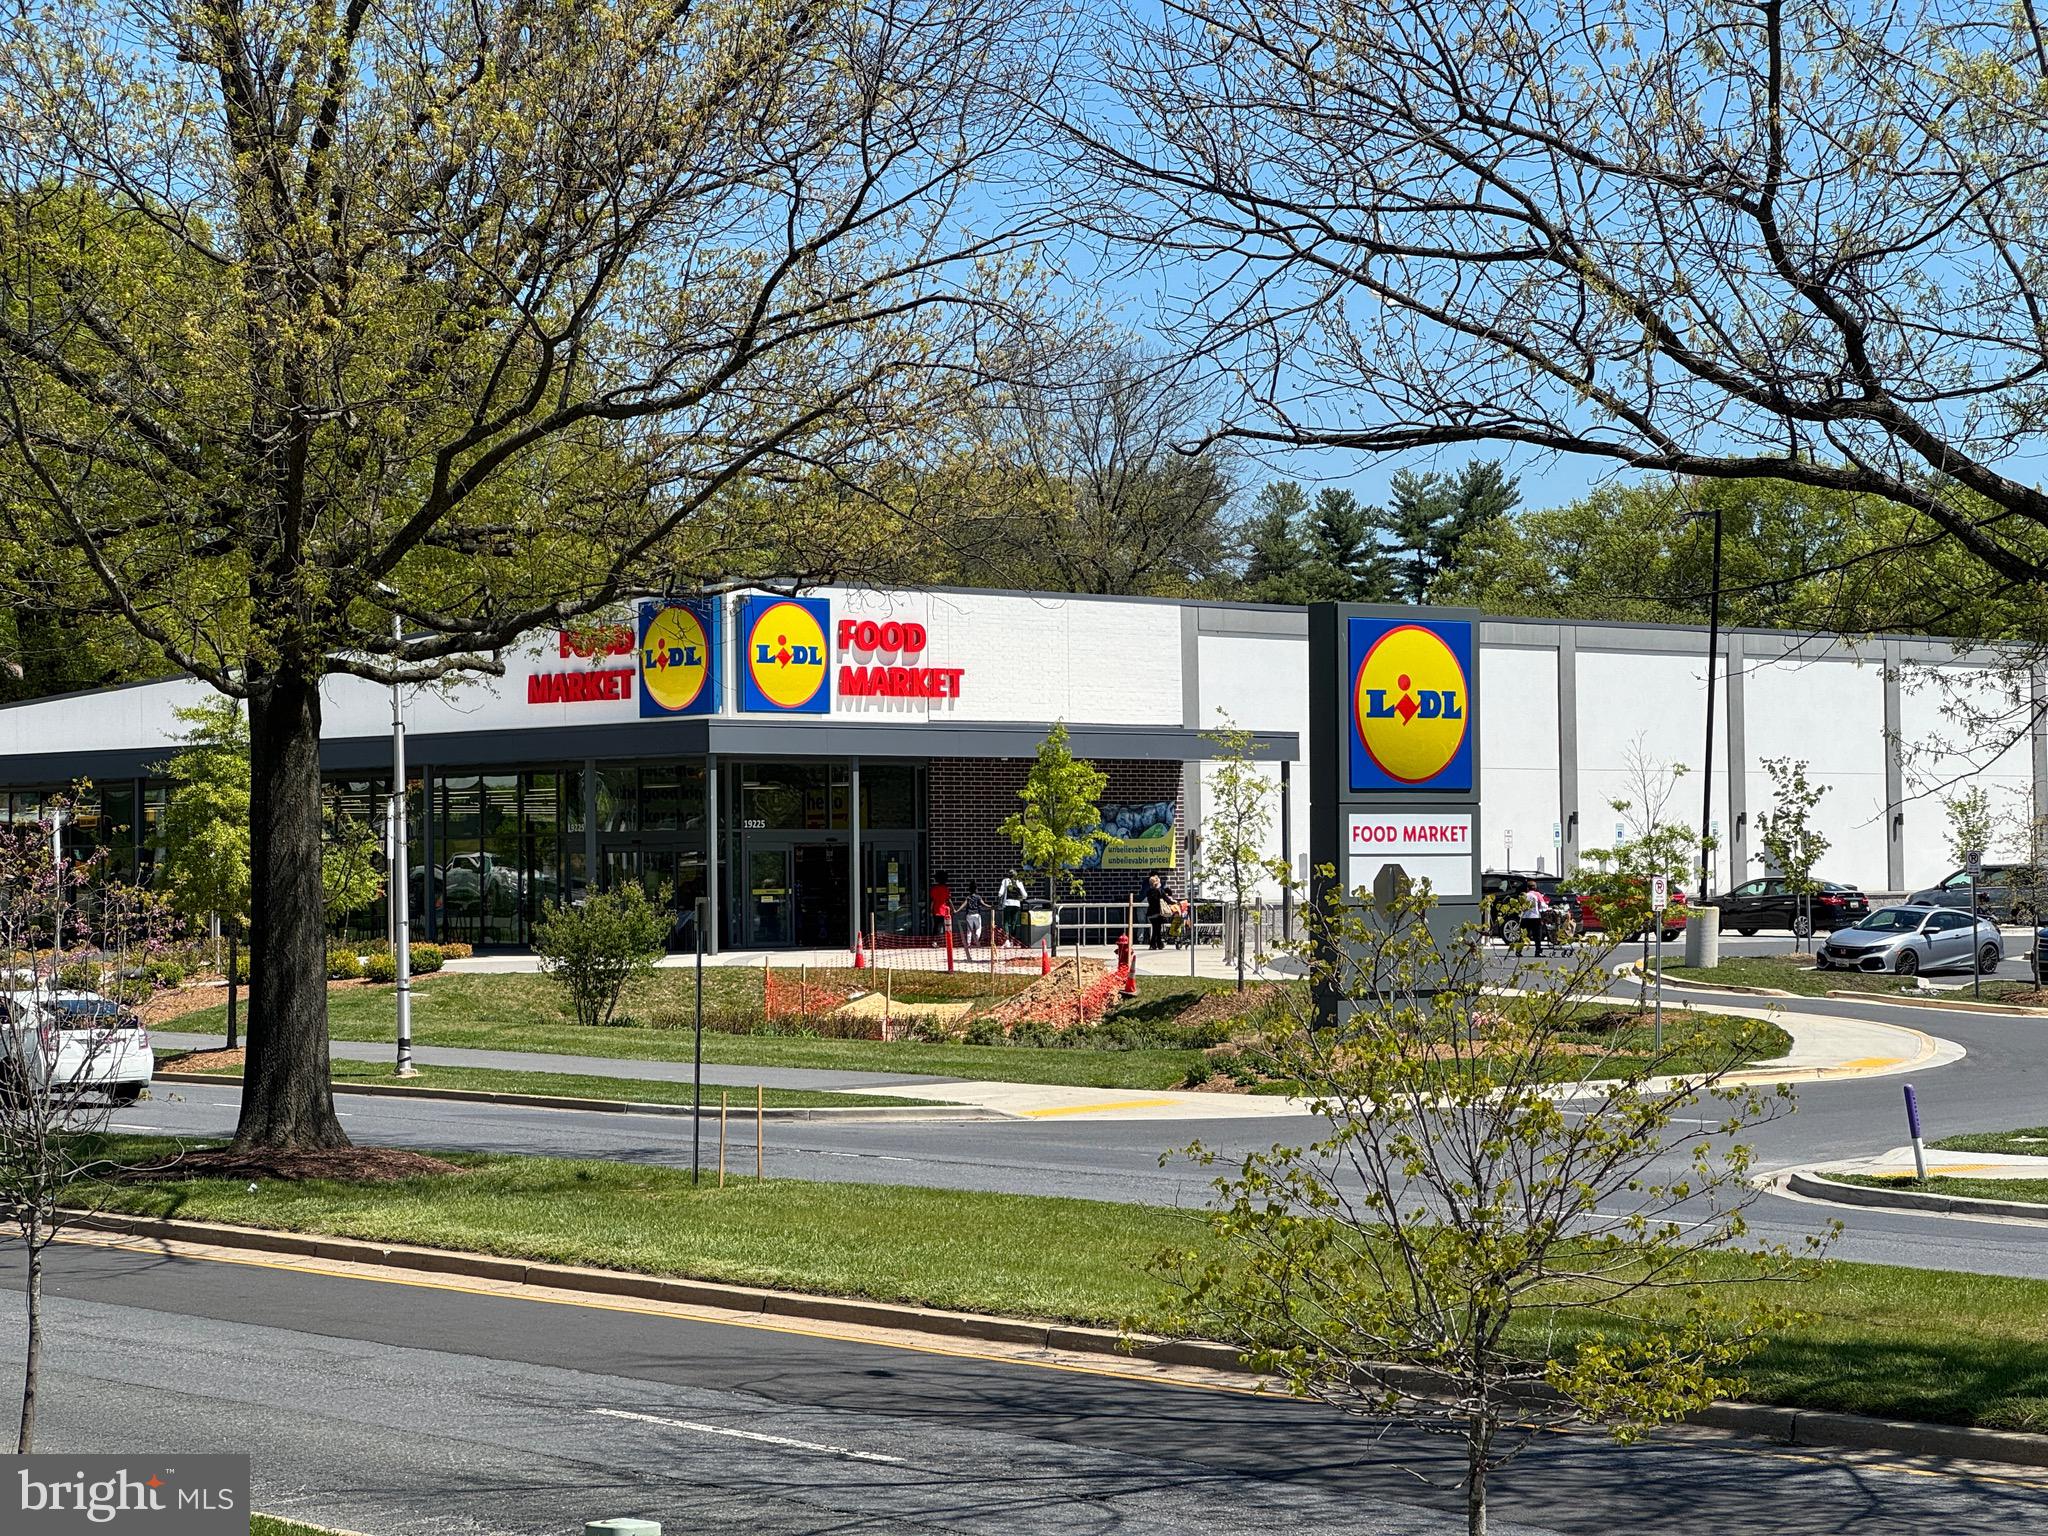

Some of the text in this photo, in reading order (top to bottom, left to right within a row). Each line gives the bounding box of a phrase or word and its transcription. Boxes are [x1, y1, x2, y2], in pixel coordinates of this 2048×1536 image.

[838, 619, 927, 653] FOOD
[528, 669, 636, 704] MARKET
[839, 666, 965, 699] MARKET
[744, 820, 766, 829] 19225
[1352, 825, 1469, 843] FOOD MARKET
[1108, 845, 1148, 854] unbelievable
[1108, 856, 1148, 864] unbelievable
